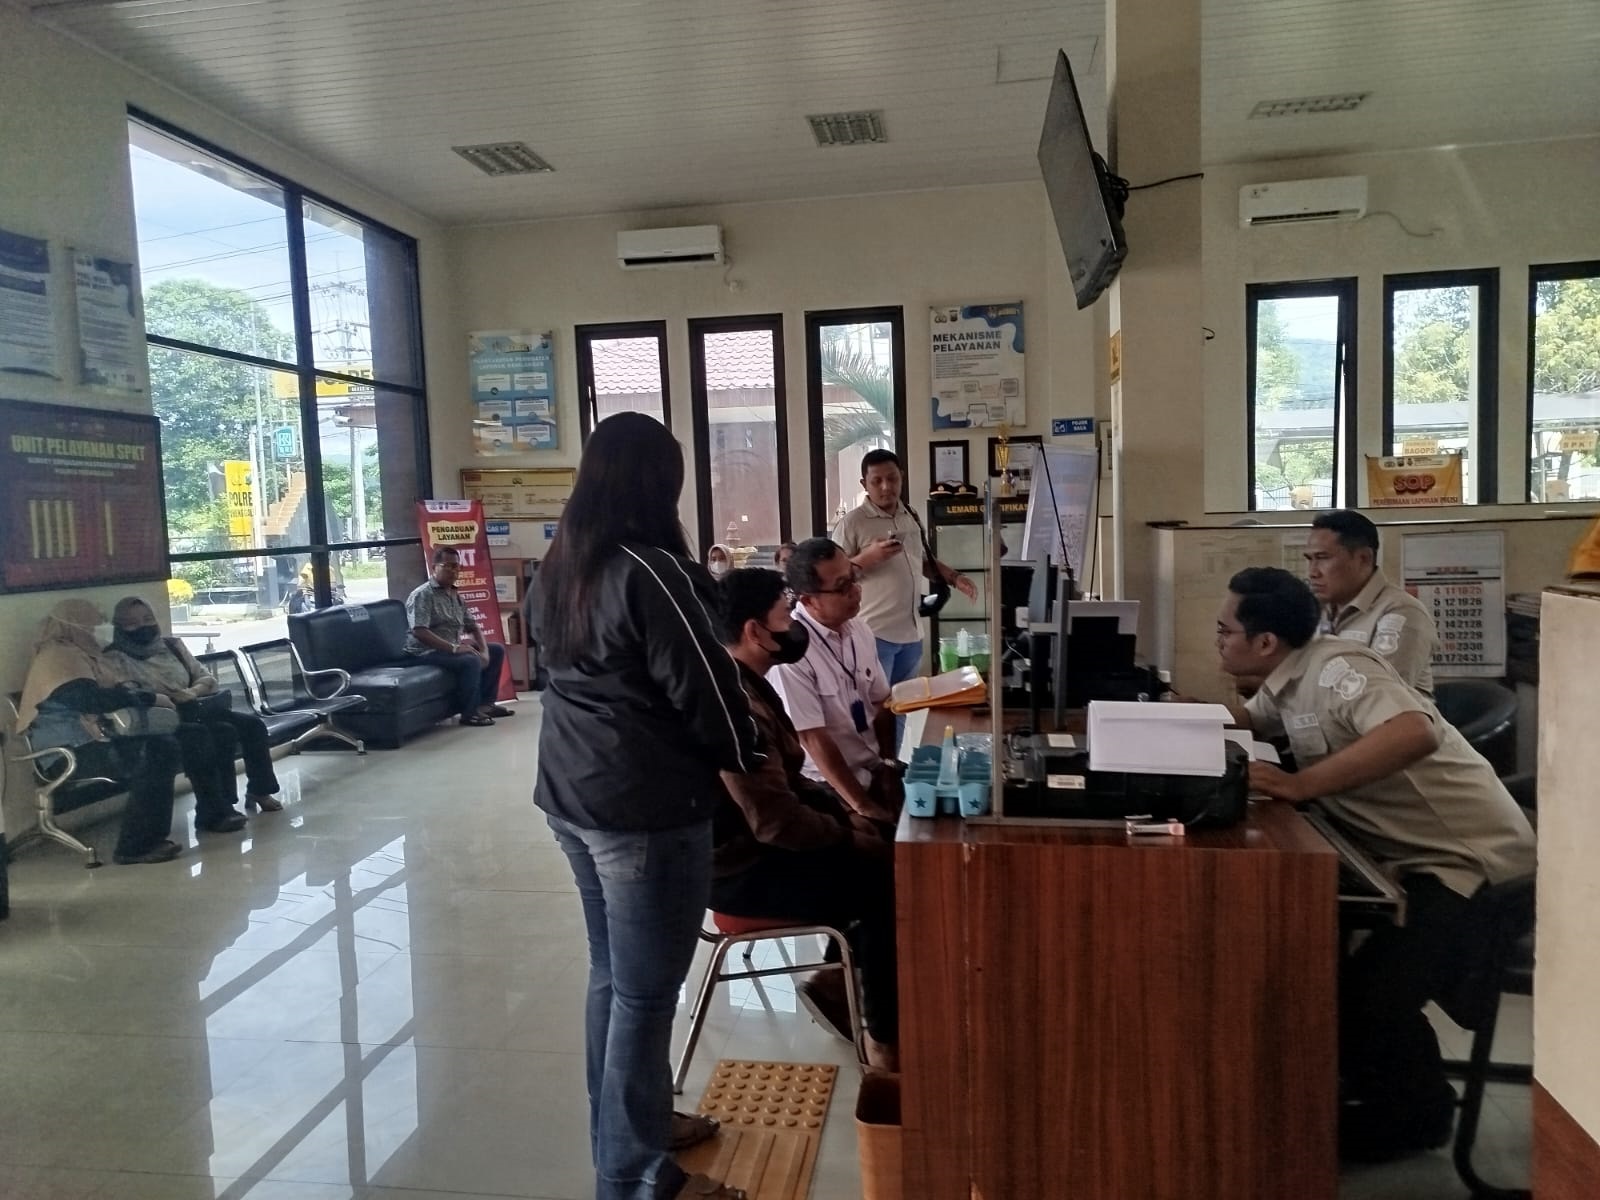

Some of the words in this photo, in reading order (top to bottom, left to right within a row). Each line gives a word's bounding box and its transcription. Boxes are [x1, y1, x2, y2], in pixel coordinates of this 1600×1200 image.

[933, 331, 1002, 342] MEKANISME
[933, 341, 1001, 352] PELAYANAN
[11, 435, 44, 453] UNIT
[47, 438, 114, 458] PELAYANAN
[117, 444, 145, 460] SPKT
[1394, 474, 1436, 495] SOP
[946, 503, 978, 514] LEMARI
[431, 525, 475, 533] PENGADUAN
[437, 533, 471, 541] LAYANAN
[1434, 598, 1440, 606] 5
[1445, 598, 1455, 606] 12
[1457, 598, 1468, 606] 19
[1470, 598, 1482, 606] 26
[1434, 609, 1440, 617] 6
[1445, 609, 1455, 617] 13
[1457, 609, 1468, 617] 20
[1470, 609, 1482, 617] 27
[1445, 620, 1455, 628] 14
[1457, 620, 1468, 628] 21
[1470, 620, 1482, 628] 28
[1432, 654, 1441, 662] 10
[1445, 654, 1455, 662] 17
[1457, 654, 1468, 662] 24
[1470, 654, 1482, 662] 31
